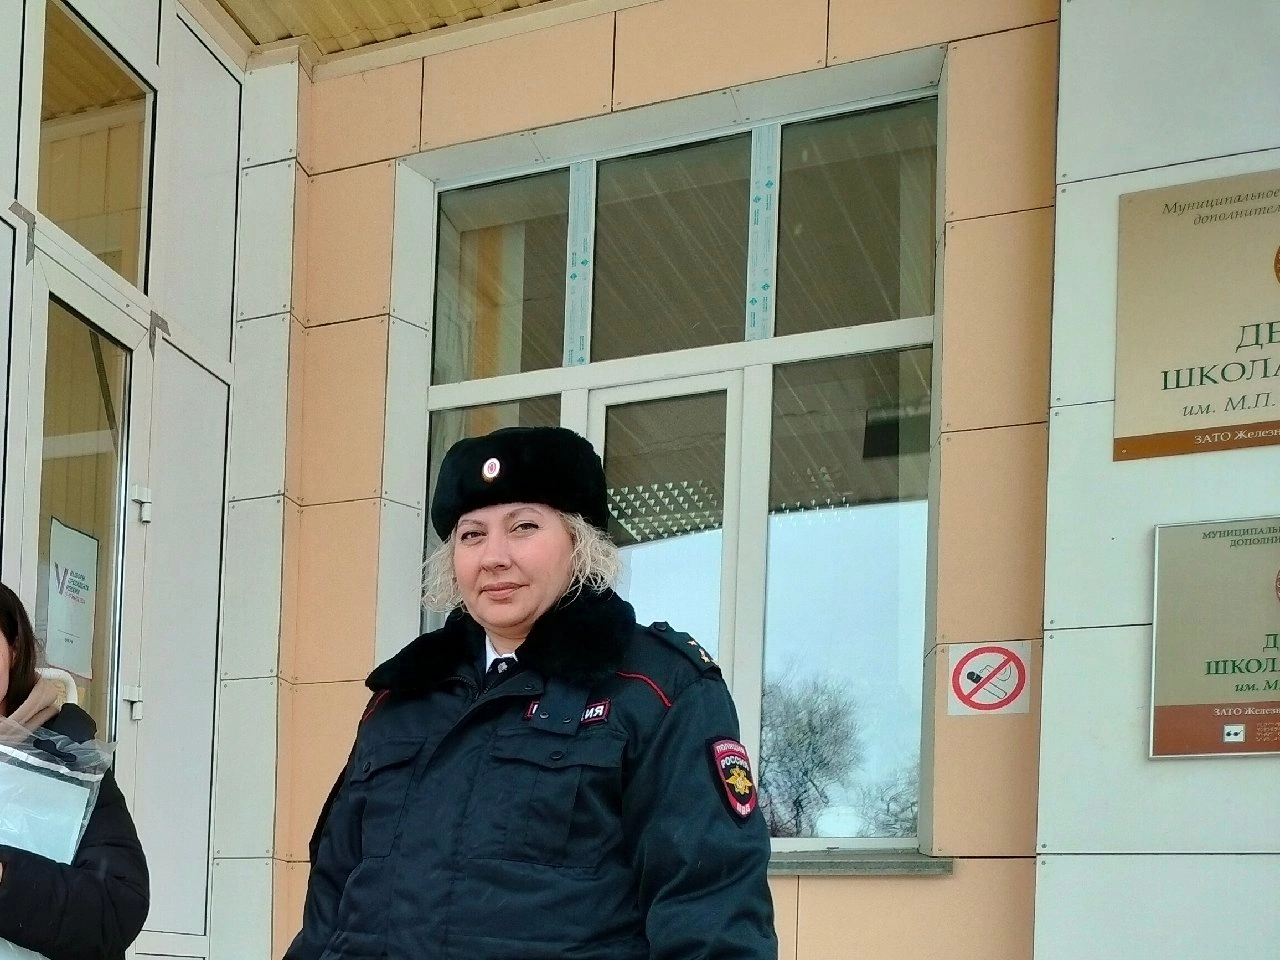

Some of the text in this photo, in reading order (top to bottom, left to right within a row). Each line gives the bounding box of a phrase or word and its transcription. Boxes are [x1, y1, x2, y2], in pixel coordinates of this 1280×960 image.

[1162, 188, 1280, 216] Муниципальное
[1182, 403, 1216, 417] им.
[1194, 431, 1231, 445] ЗАТО
[1204, 657, 1280, 676] ШКОЛ
[1234, 683, 1259, 692] им.
[1214, 707, 1242, 717] ЗАТО
